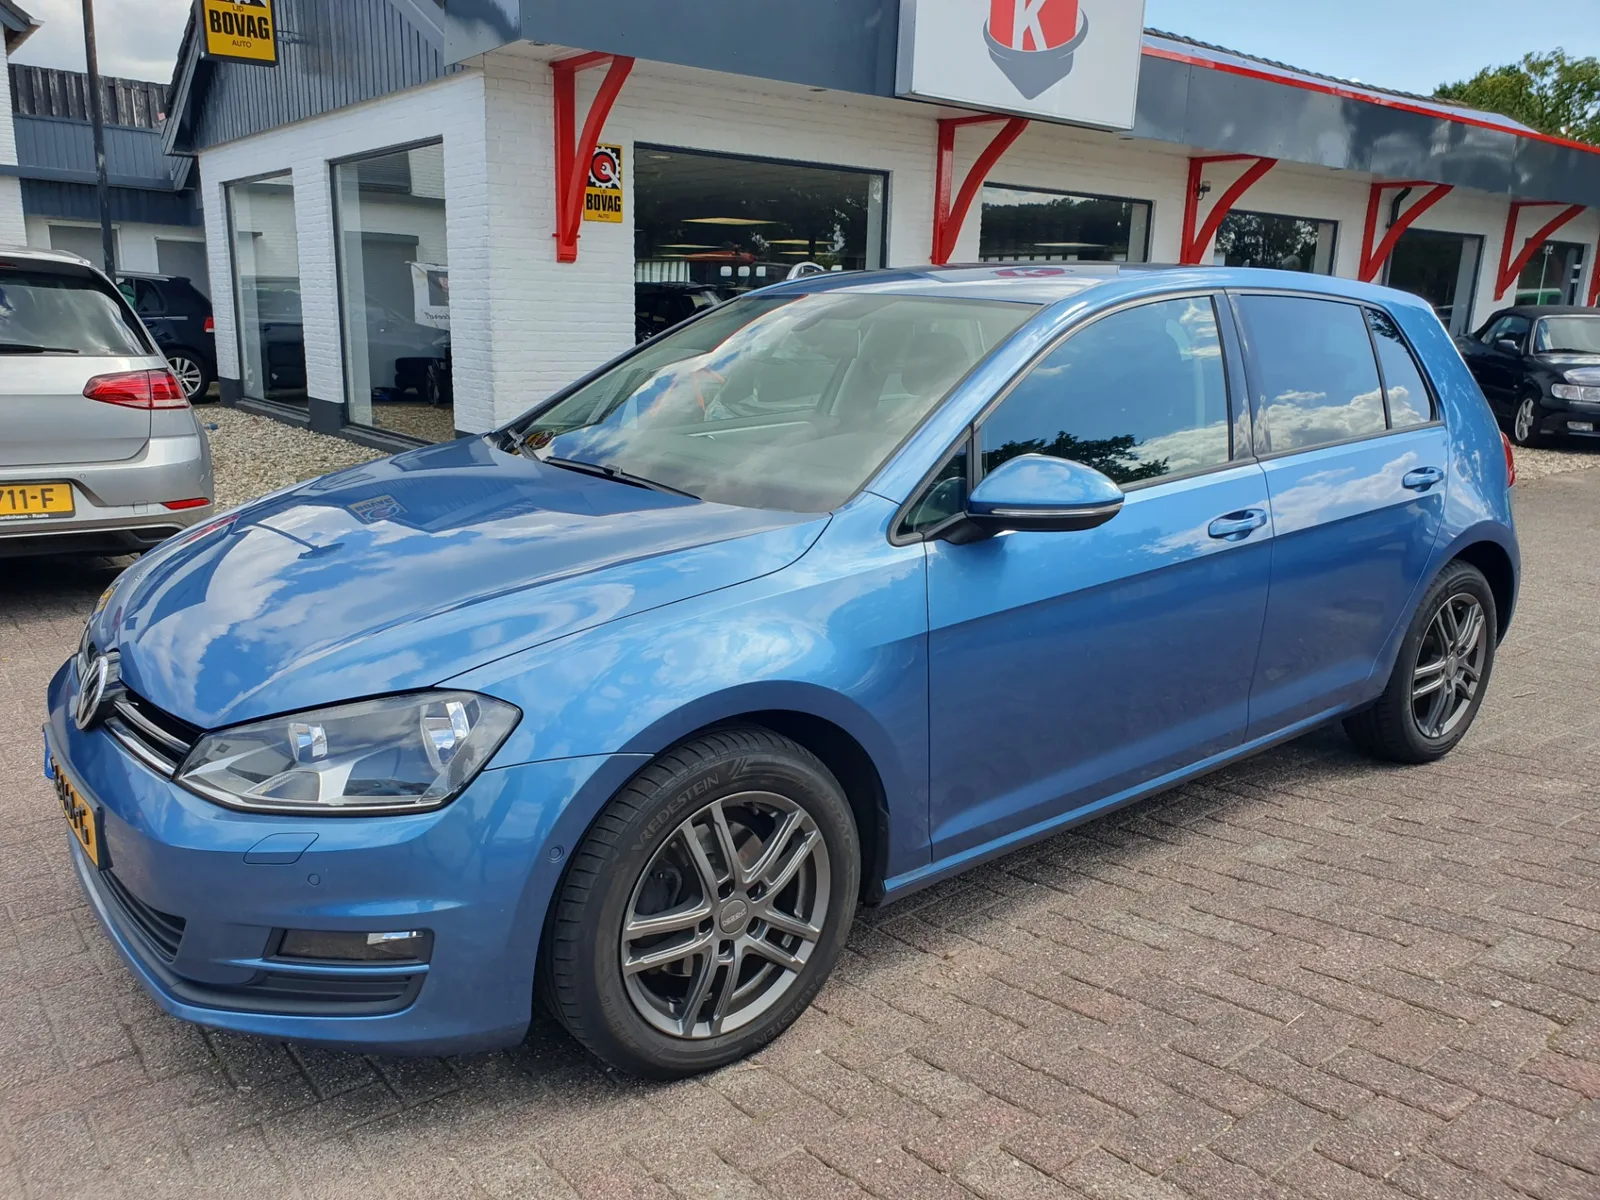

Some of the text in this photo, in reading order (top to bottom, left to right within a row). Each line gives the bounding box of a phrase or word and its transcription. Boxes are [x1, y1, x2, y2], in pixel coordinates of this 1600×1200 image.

[209, 9, 270, 40] BOVAG
[1012, 0, 1049, 50] K
[232, 40, 252, 48] AUTO
[586, 193, 621, 212] BOVAG
[630, 772, 720, 852] VREDESTEIN
